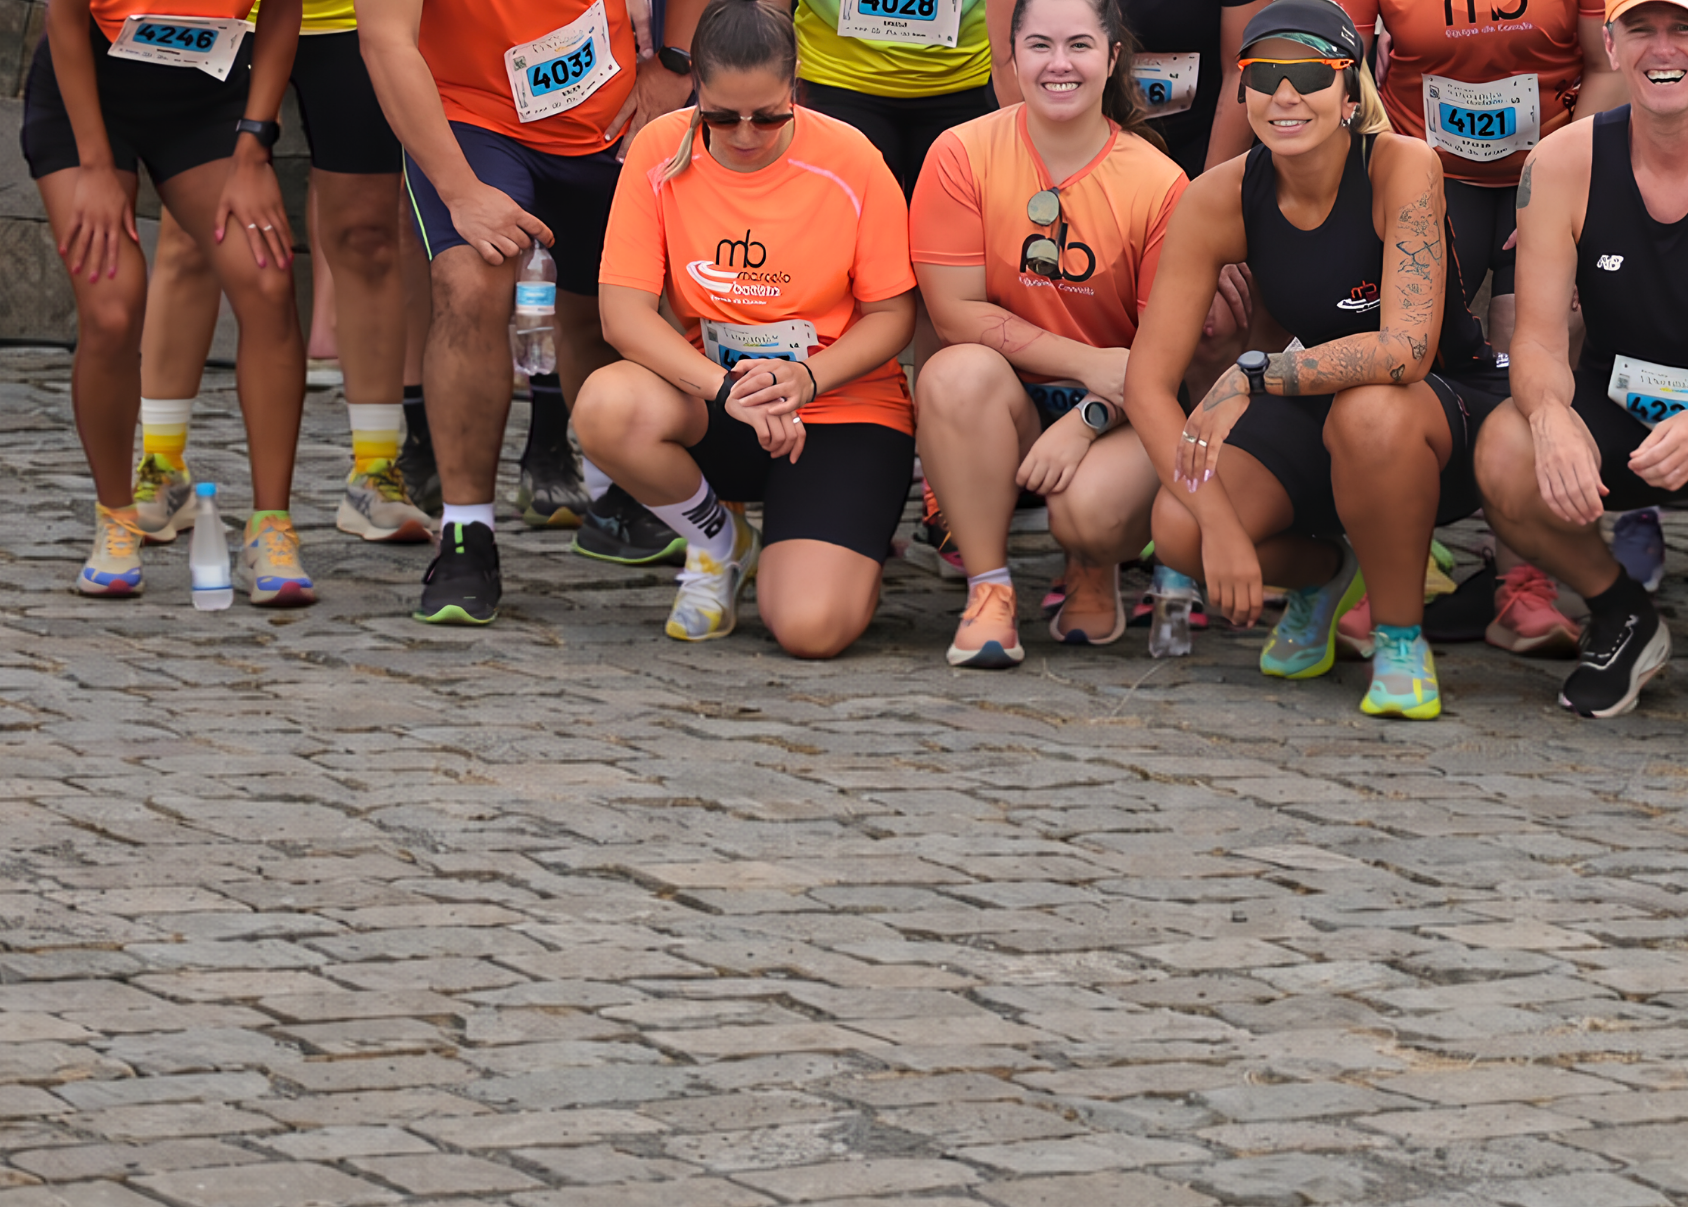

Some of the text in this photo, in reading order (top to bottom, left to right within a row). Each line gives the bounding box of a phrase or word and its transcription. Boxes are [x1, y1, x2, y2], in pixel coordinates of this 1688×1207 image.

[136, 23, 215, 50] 4246
[532, 40, 594, 91] 4033
[1448, 107, 1507, 138] 4121
[716, 228, 767, 269] mb
